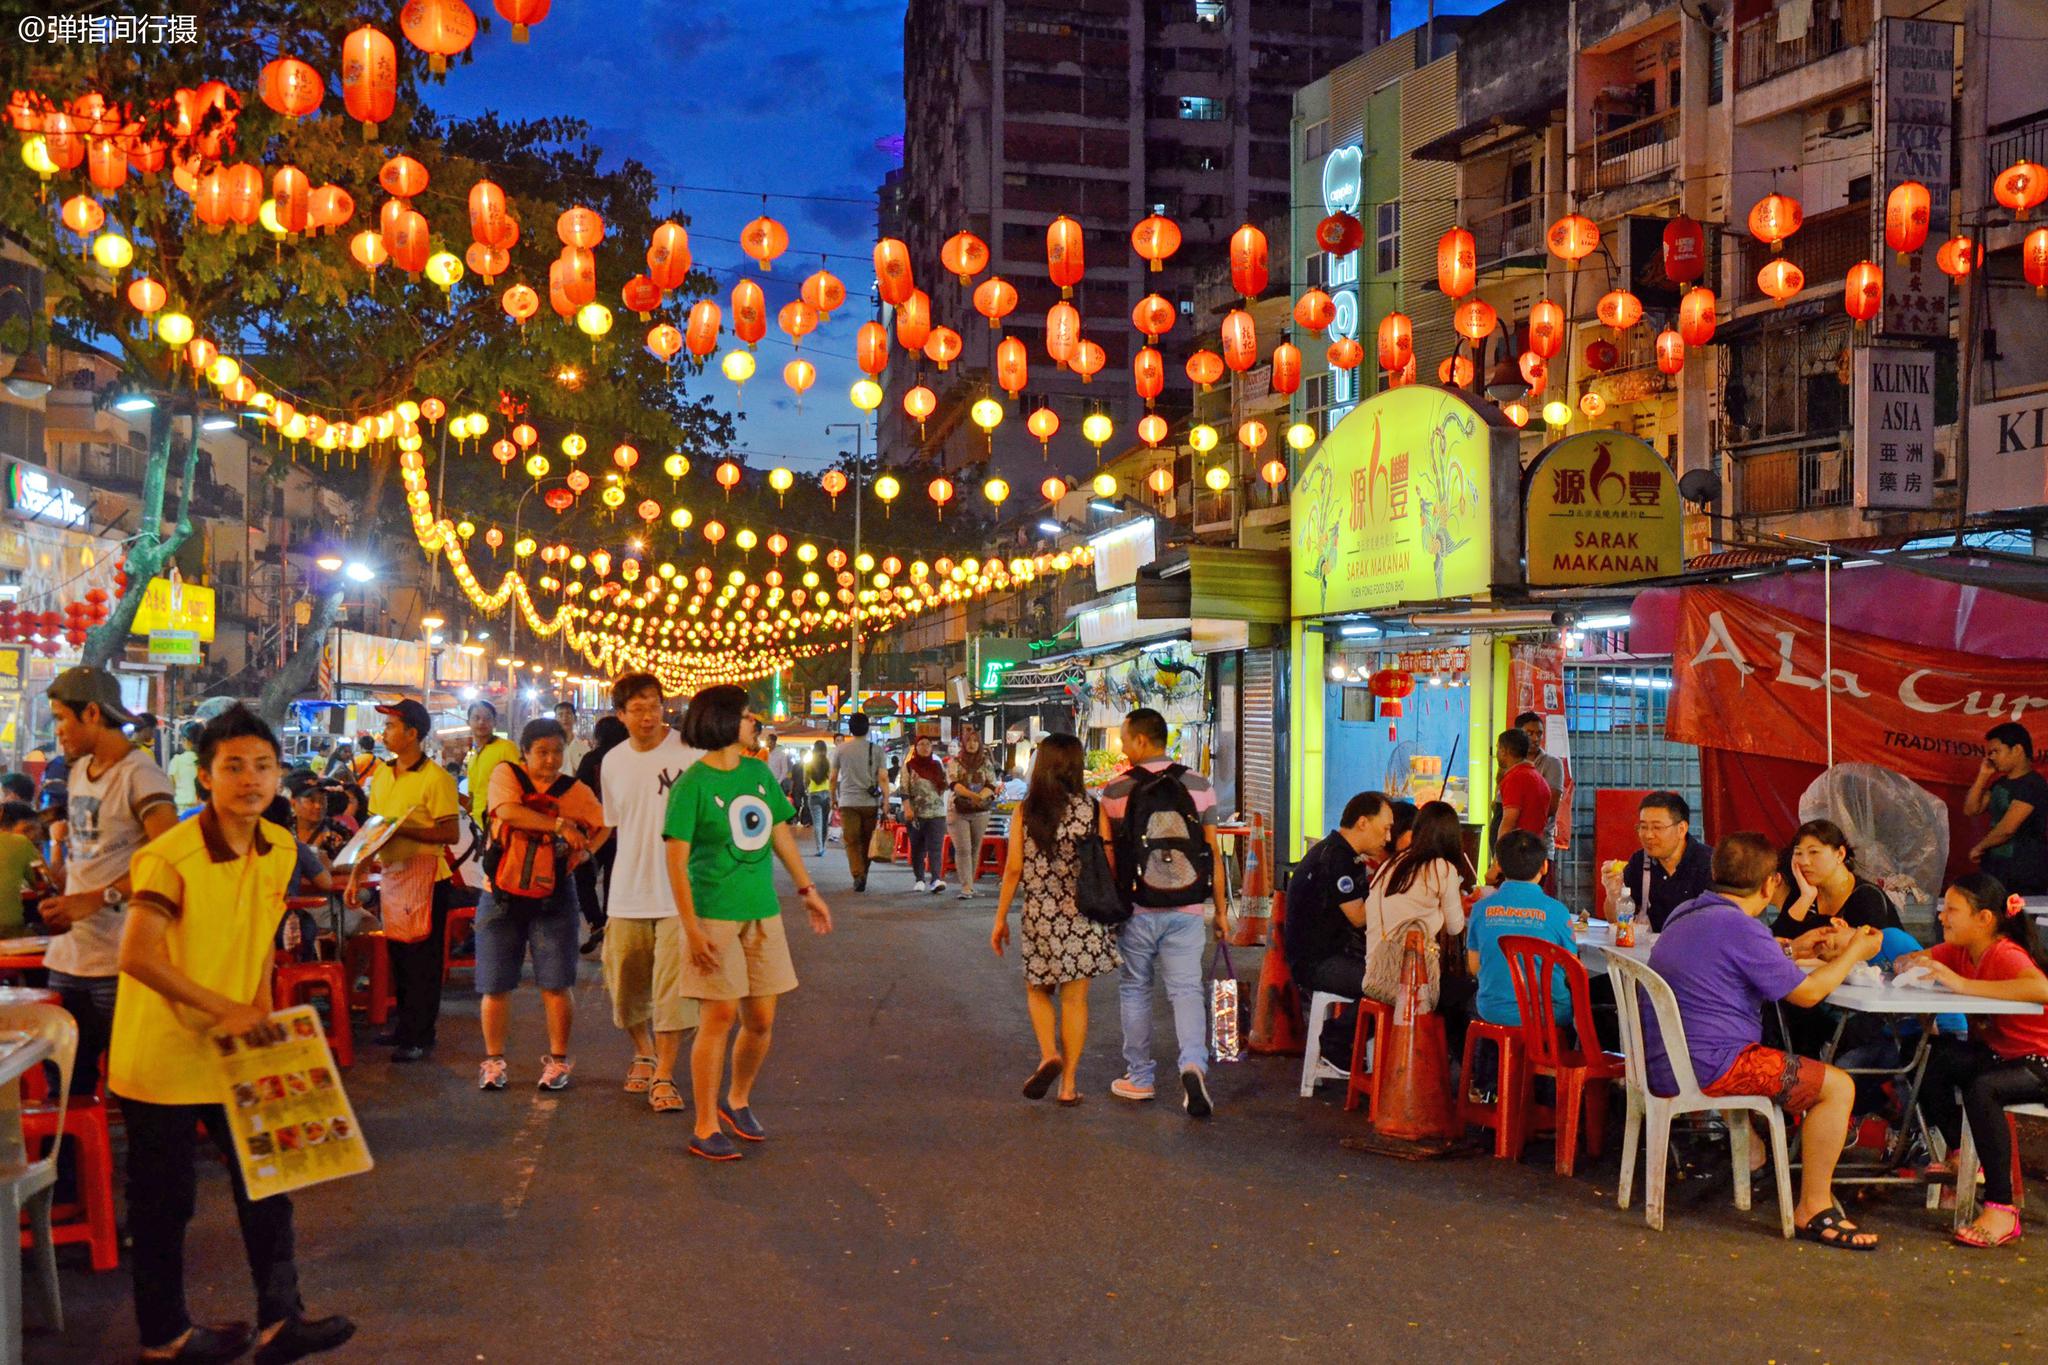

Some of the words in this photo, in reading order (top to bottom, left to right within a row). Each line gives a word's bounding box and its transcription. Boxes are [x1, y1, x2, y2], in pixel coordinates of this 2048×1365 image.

[1903, 21, 1938, 46] PUSAT
[1902, 71, 1937, 95] CHINA
[1896, 124, 1943, 150] KOK
[1894, 150, 1942, 177] ANN
[1872, 363, 1930, 394] KLINIK
[1881, 401, 1922, 432] ASIA
[1879, 472, 1922, 493] 藥房
[1574, 531, 1639, 549] SARAK
[1347, 558, 1369, 581] SARAK
[1371, 551, 1410, 577] MAKANAN
[1553, 554, 1659, 572] MAKANAN
[1374, 583, 1385, 595] FOOD
[153, 642, 190, 651] HOTEL
[1690, 611, 1755, 674] A
[1775, 631, 1871, 698] La
